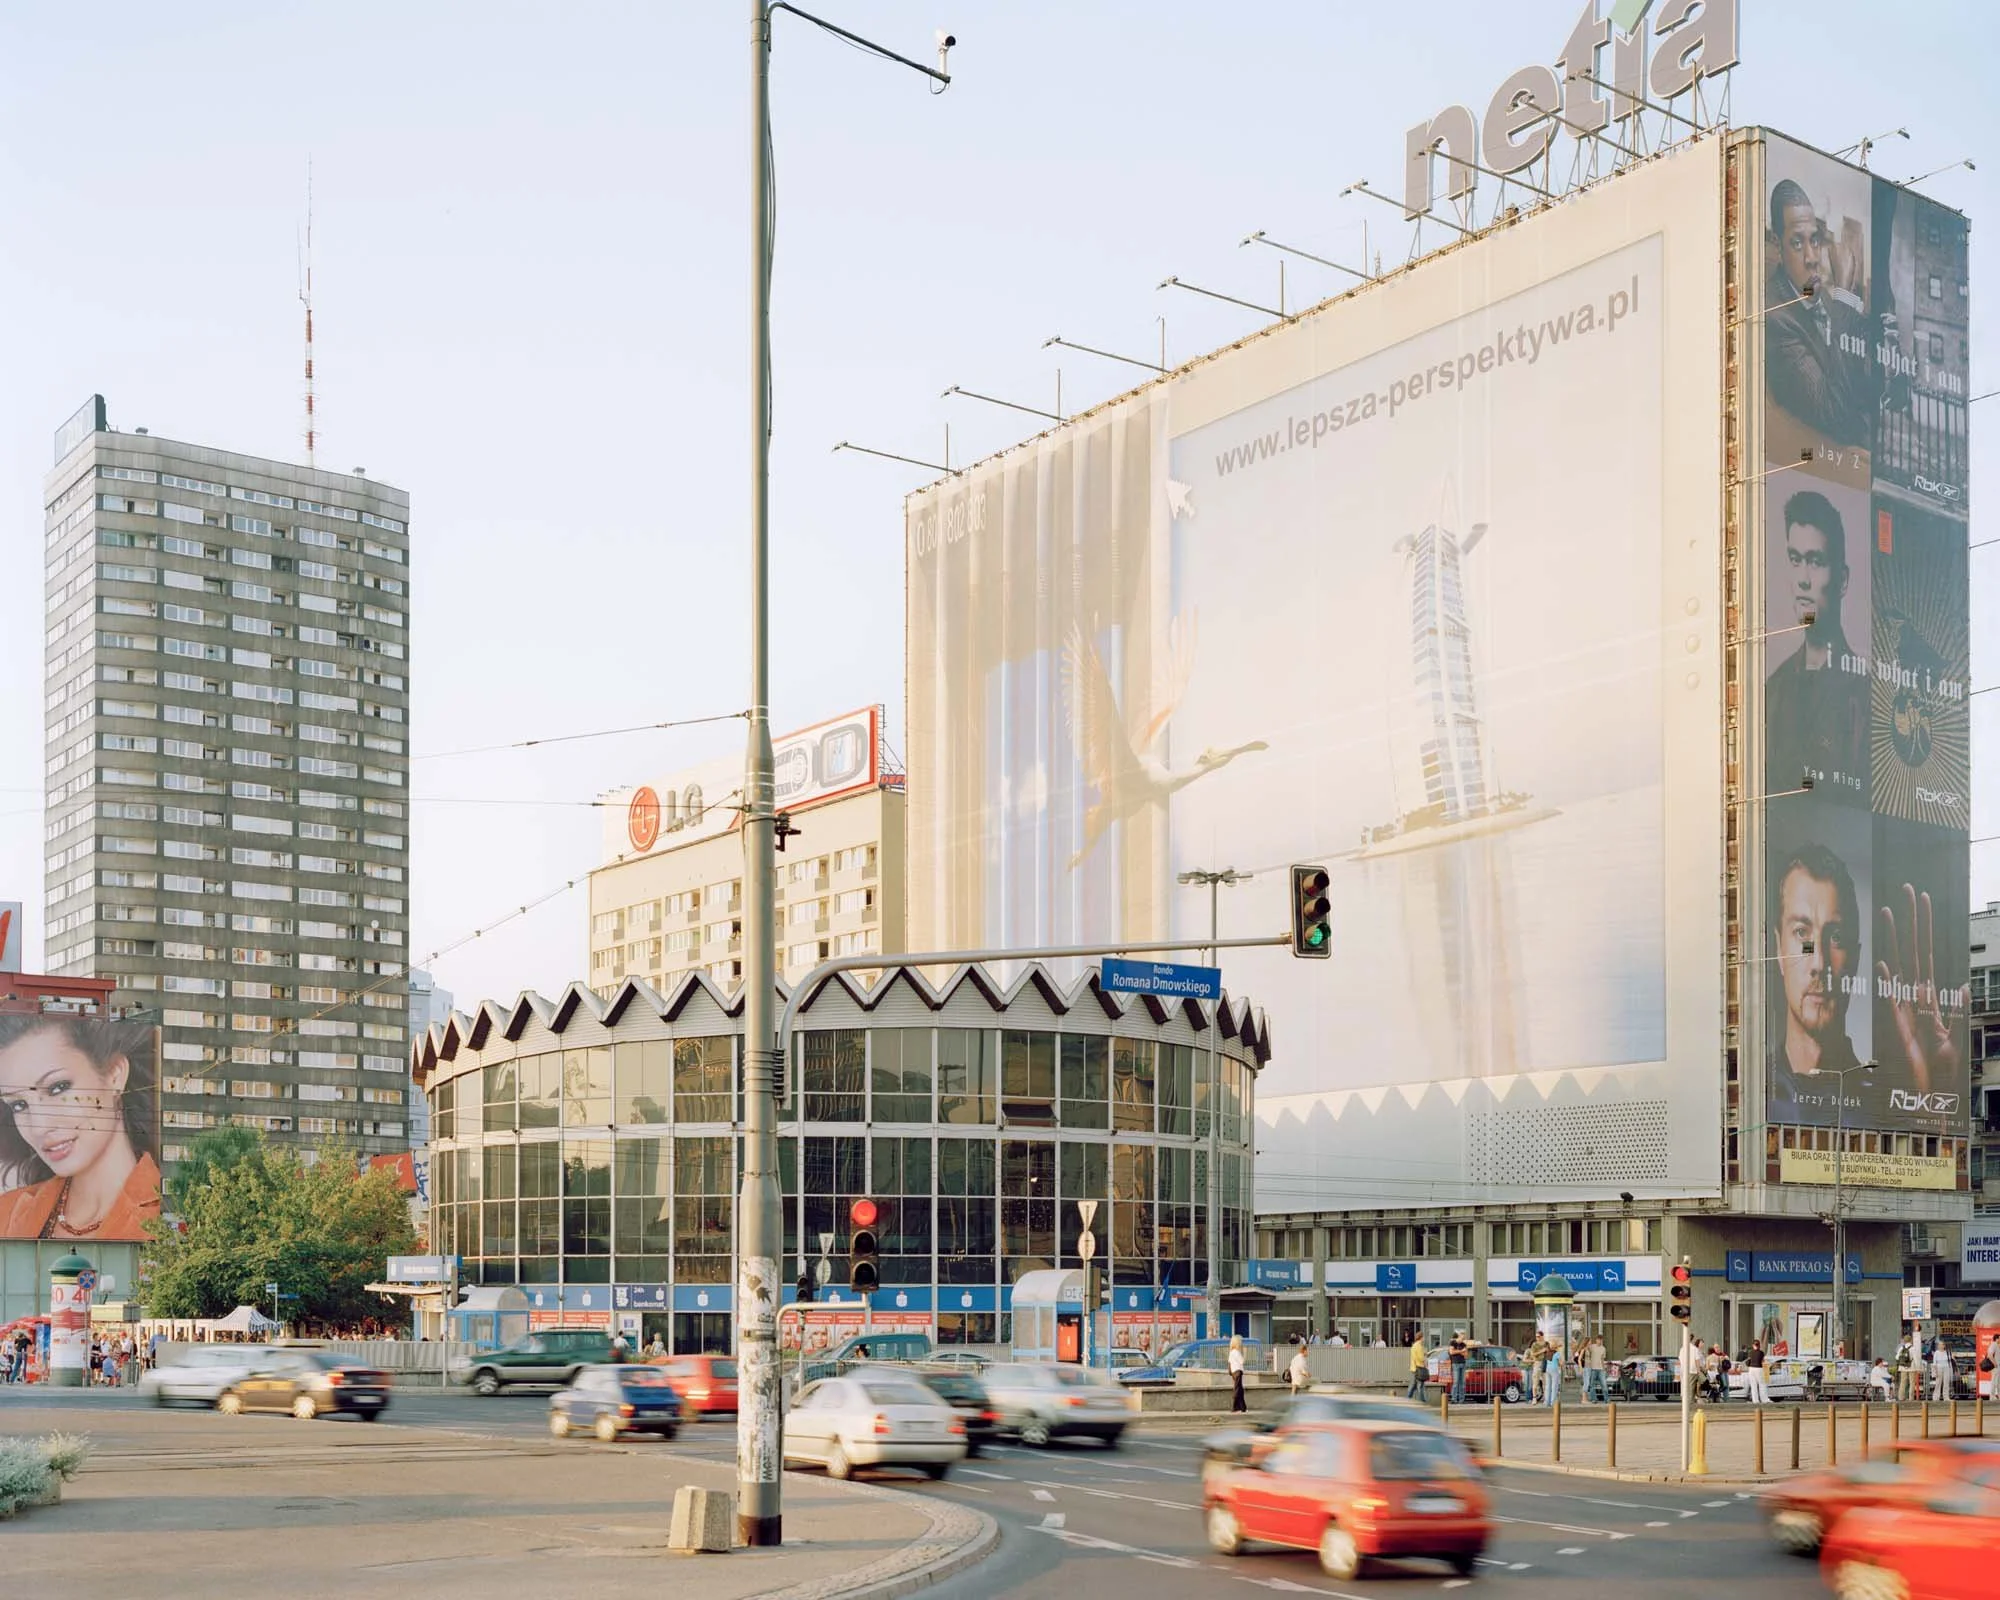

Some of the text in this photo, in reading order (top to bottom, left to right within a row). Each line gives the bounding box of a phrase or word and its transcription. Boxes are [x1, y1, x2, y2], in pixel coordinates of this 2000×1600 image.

[1404, 0, 1740, 222] netia
[1839, 332, 1866, 358] am
[1876, 341, 1918, 377] what
[1924, 358, 1931, 382] i
[1938, 370, 1962, 394] am
[1215, 274, 1640, 477] www.lepsza-perspektywa.pl
[1818, 443, 1843, 466] Jay
[947, 500, 965, 544] 802
[1826, 642, 1962, 700] i am what i am
[1833, 771, 1861, 790] Ming
[667, 783, 703, 833] LG
[1153, 964, 1174, 975] Rondo
[1113, 973, 1211, 996] Romana Dmowskiego
[1827, 965, 1963, 1008] i am what i am
[1791, 1092, 1824, 1106] Jerzy
[1791, 1151, 1812, 1160] BIURA
[1813, 1152, 1831, 1161] ORAZ
[1832, 1153, 1849, 1162] SLE
[1850, 1154, 1903, 1166] KONFERENCYJNE
[1904, 1157, 1914, 1166] DO
[1824, 1164, 1831, 1172] W
[1832, 1164, 1845, 1173] TM
[1846, 1164, 1877, 1174] BUDYNKU
[1881, 1166, 1895, 1176] TEL.
[1907, 1168, 1914, 1176] 72
[1967, 1236, 2000, 1247] JAKI MAM
[1759, 1260, 1789, 1273] BANK
[1790, 1260, 1822, 1273] PEKAO
